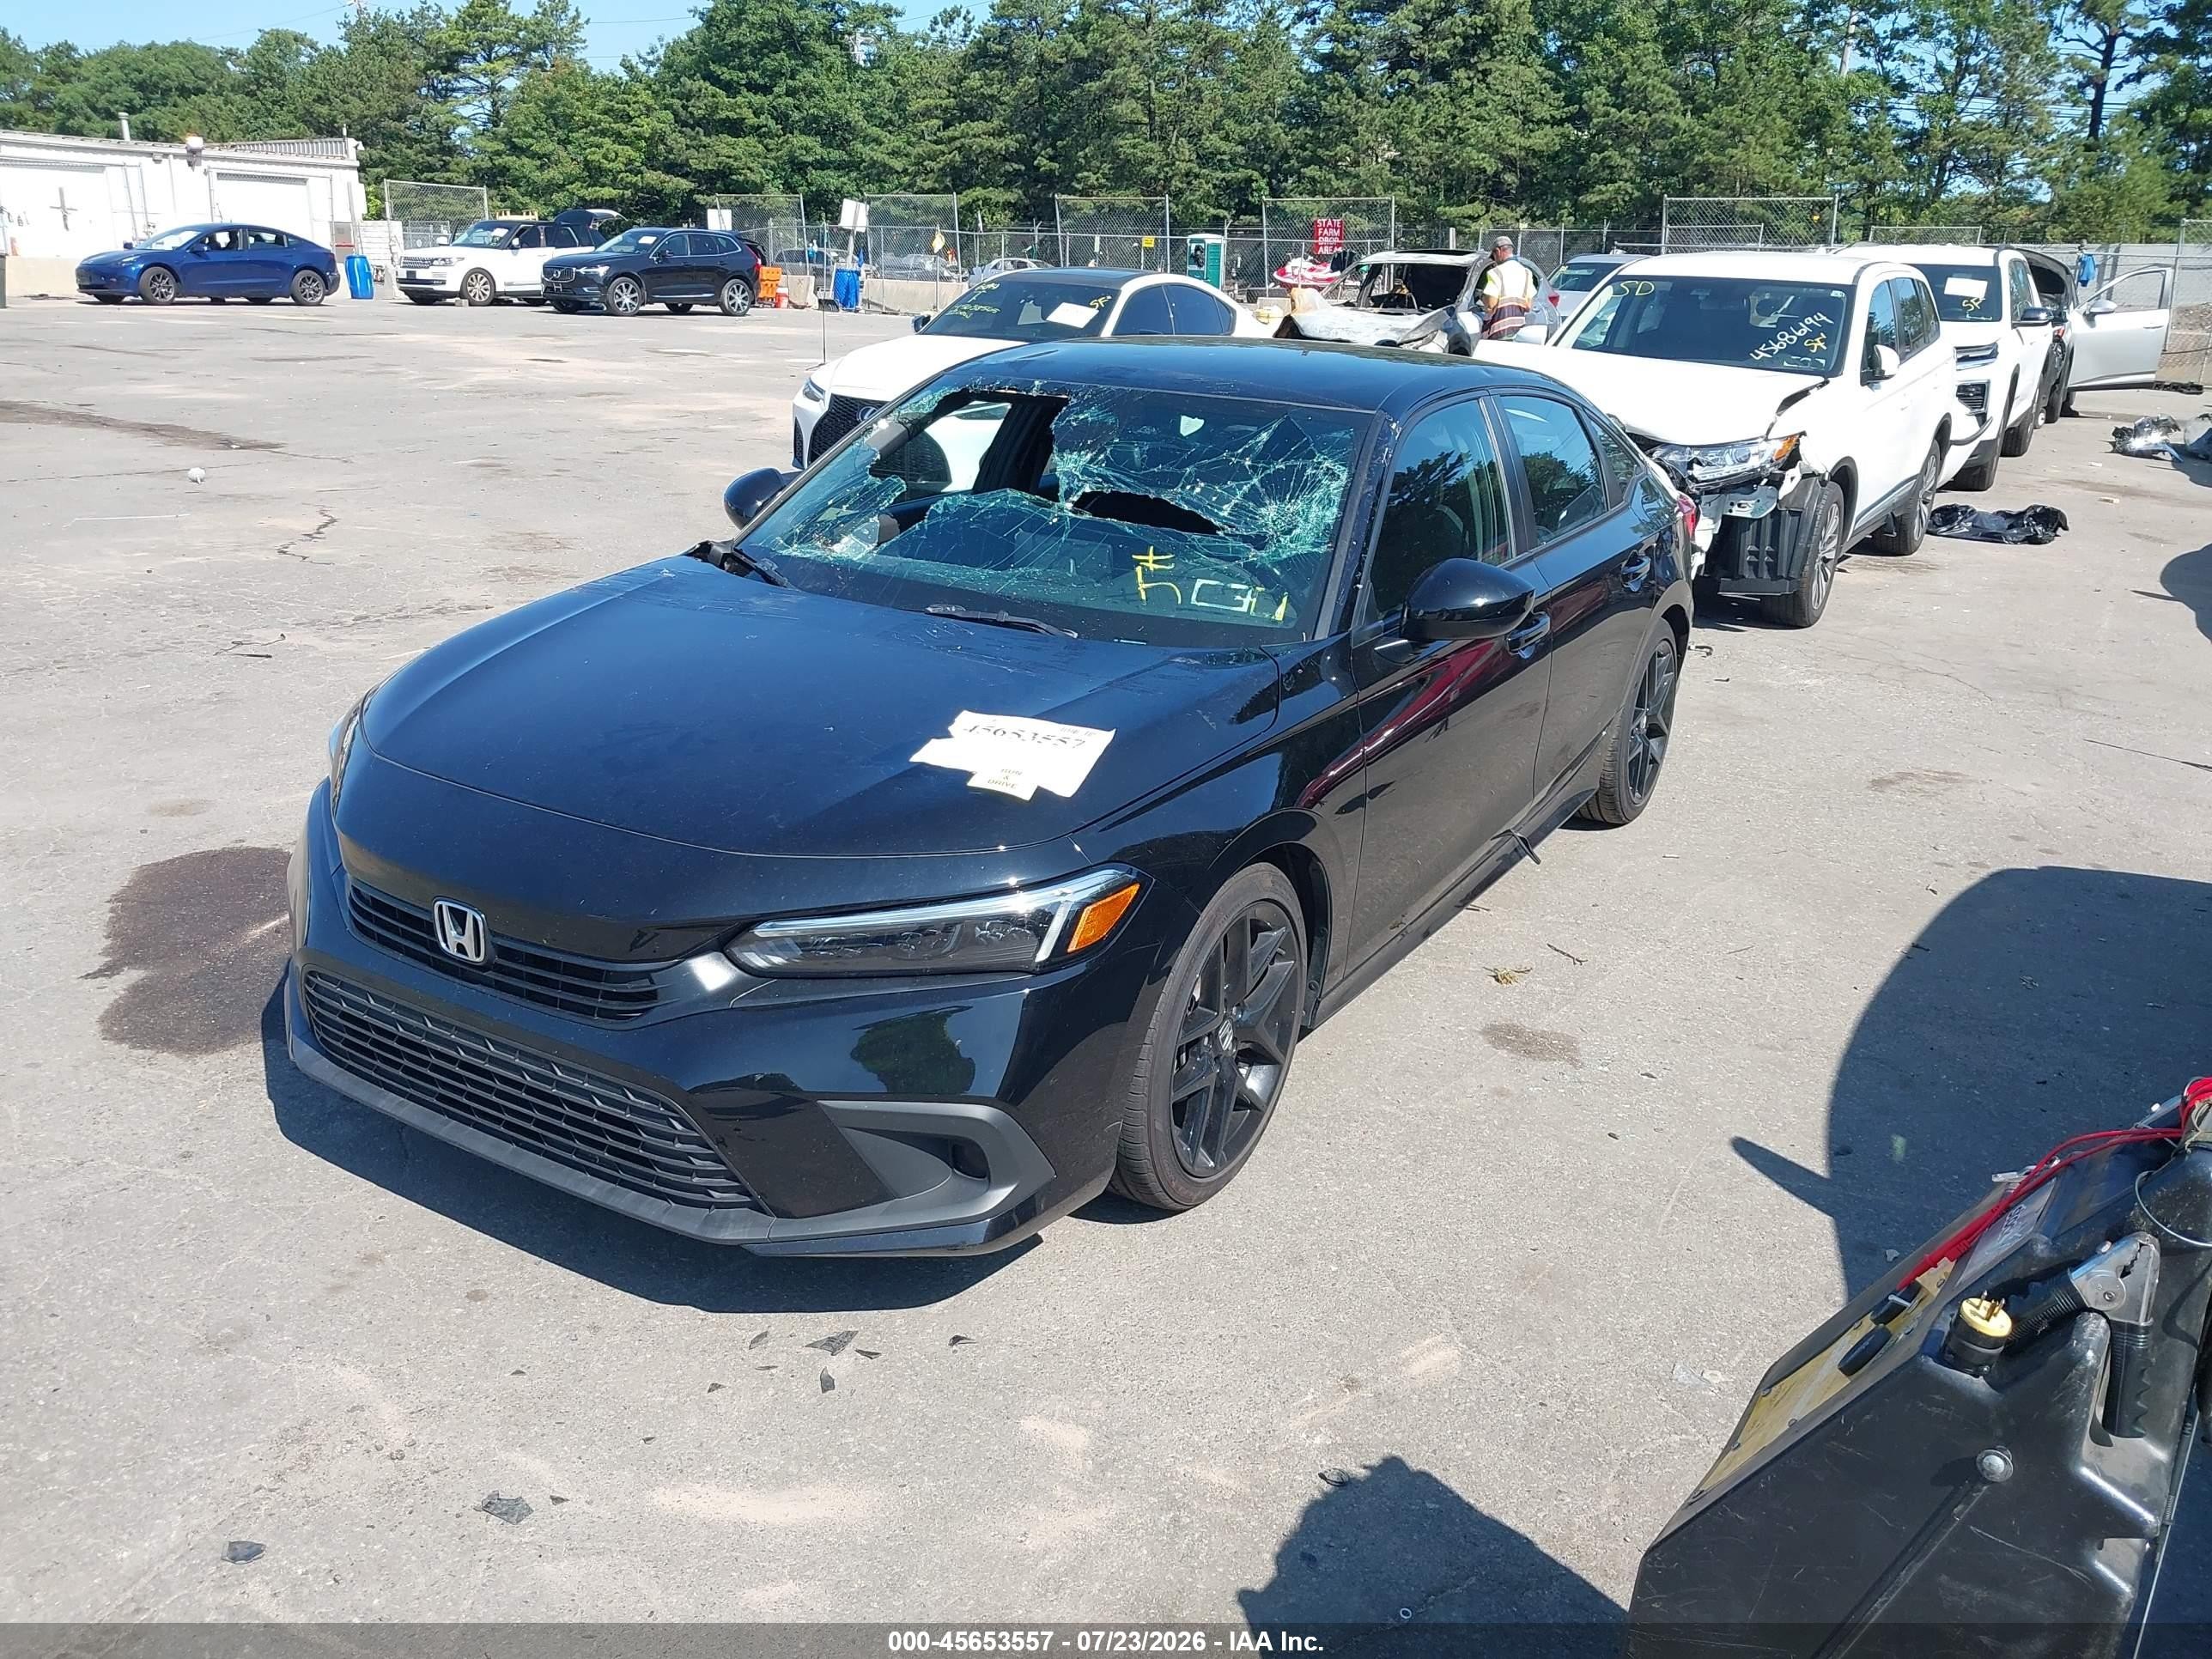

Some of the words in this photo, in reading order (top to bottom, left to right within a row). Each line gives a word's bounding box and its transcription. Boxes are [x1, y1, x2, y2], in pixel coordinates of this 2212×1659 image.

[1316, 218, 1342, 228] STATE
[1318, 228, 1340, 237] FARM
[1318, 237, 1340, 246] DROP
[1749, 312, 1834, 361] 45686194
